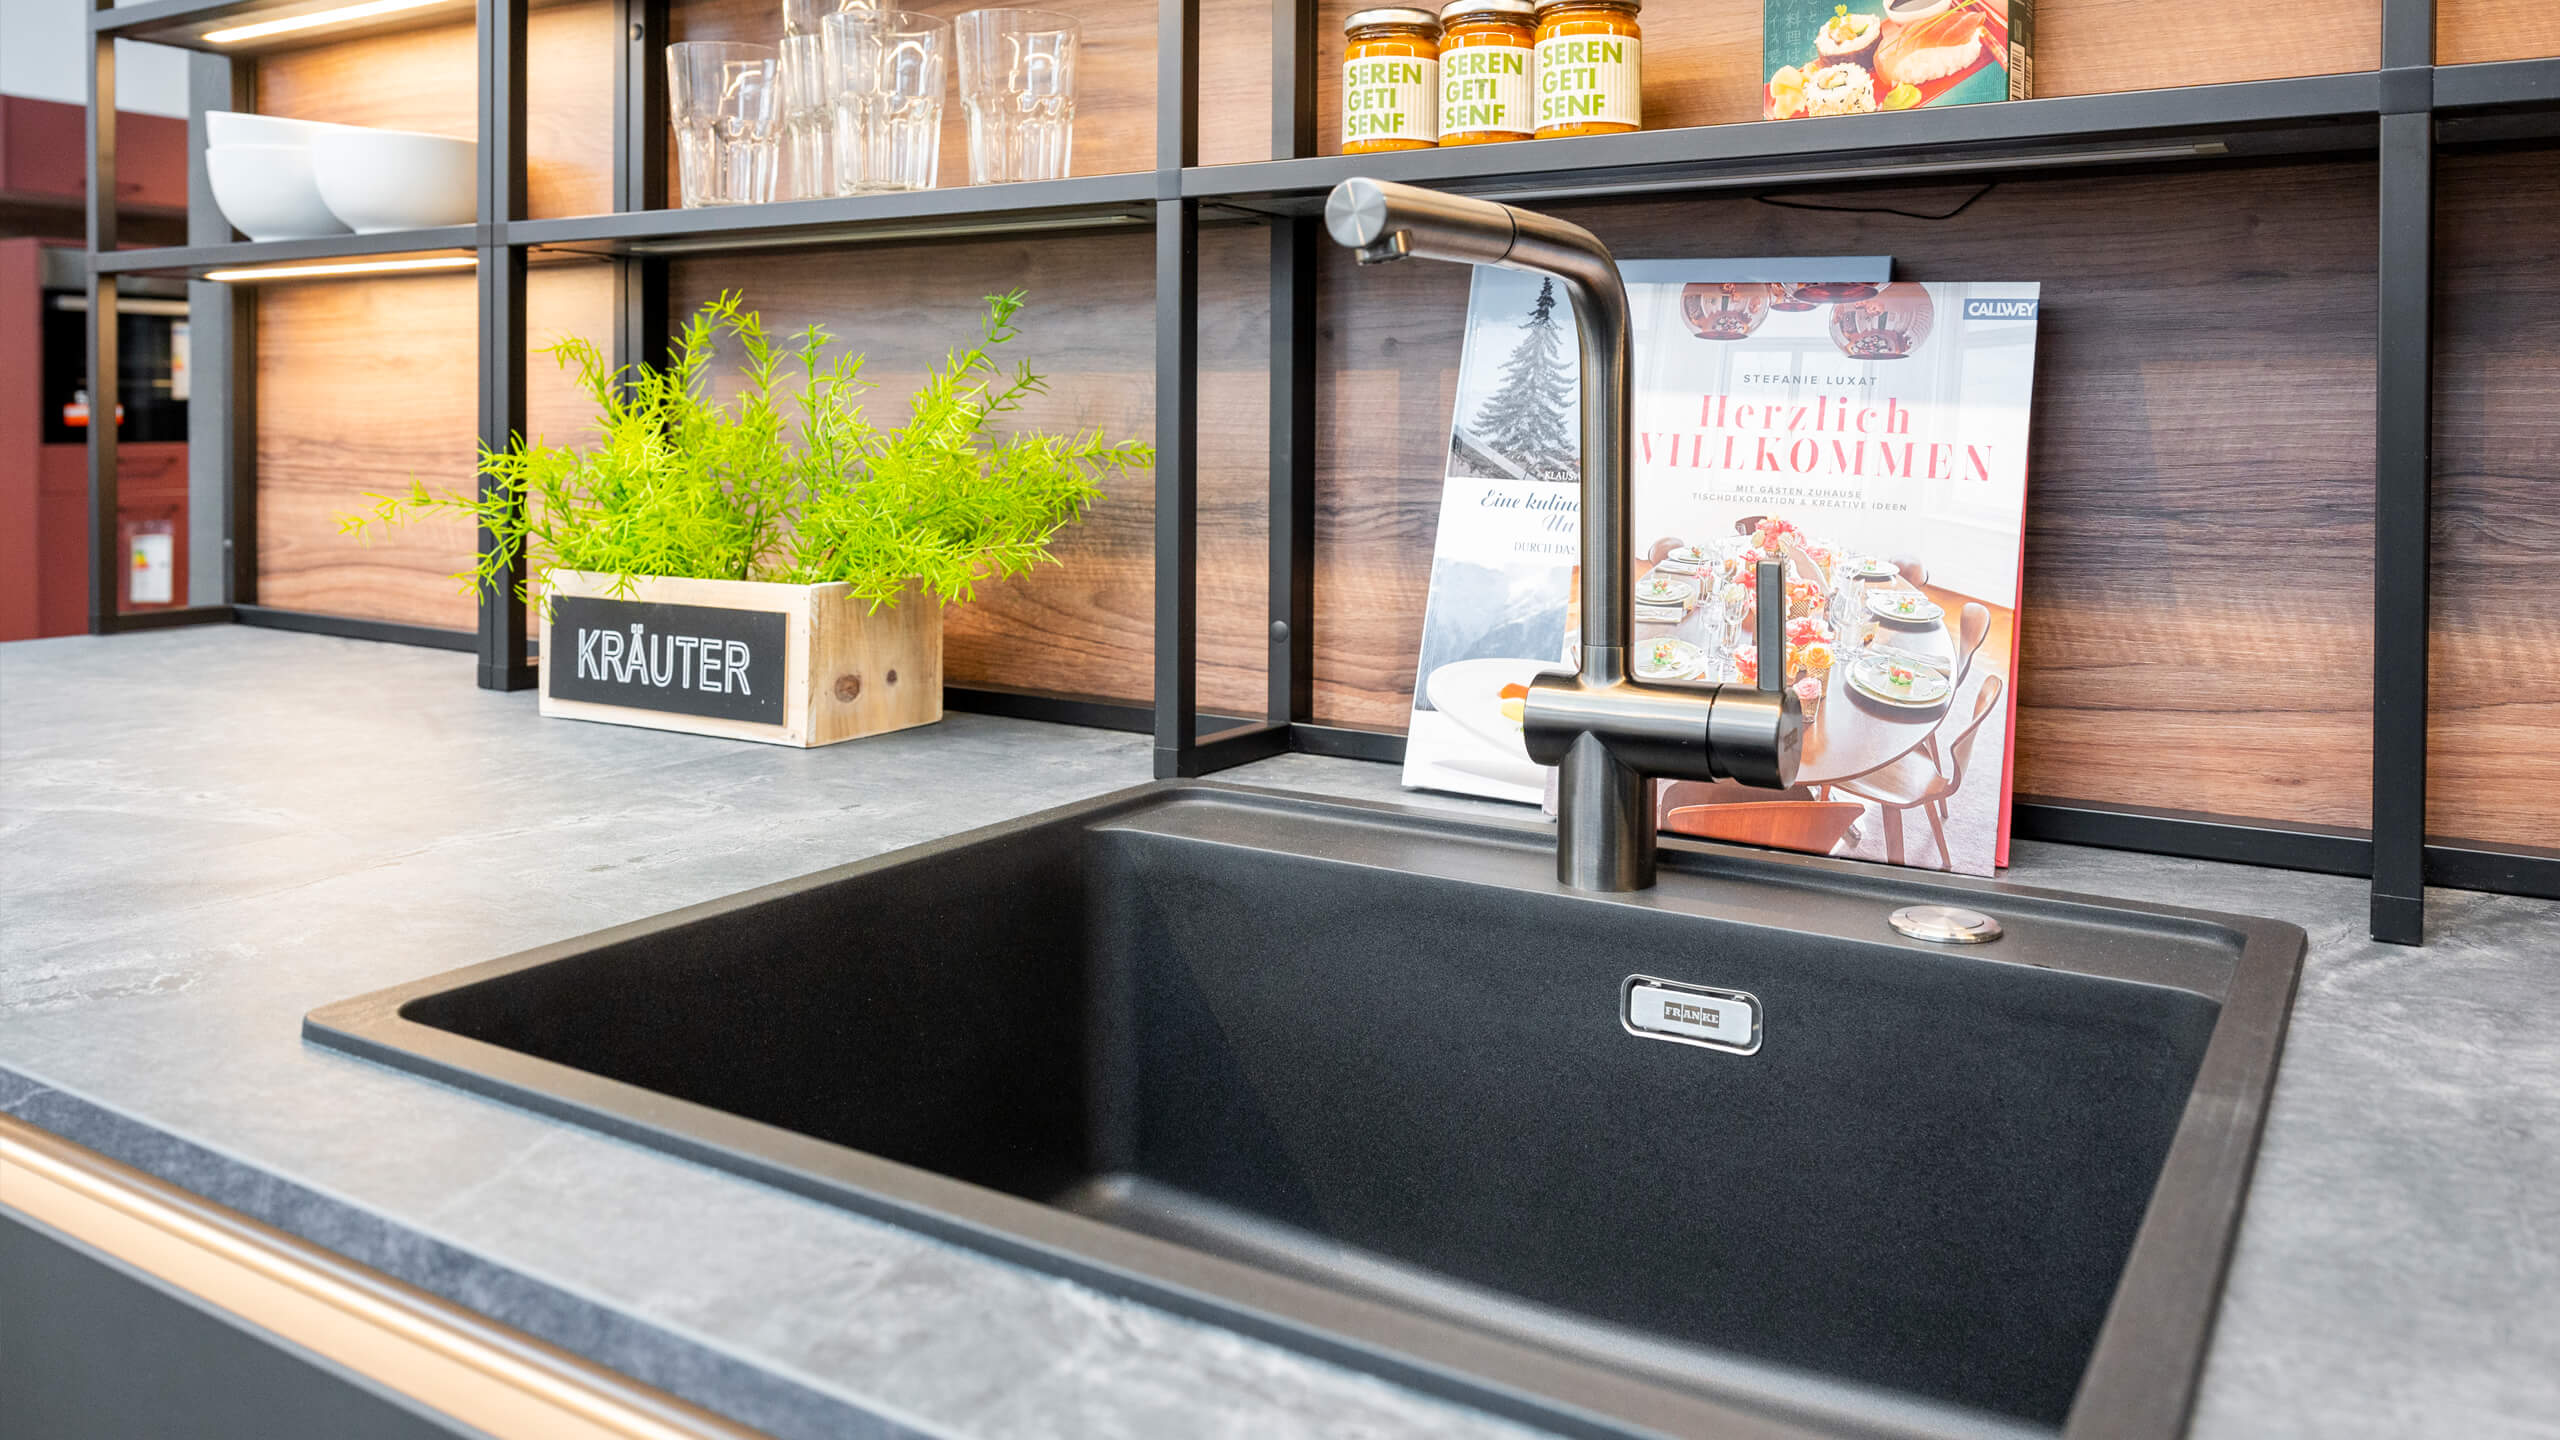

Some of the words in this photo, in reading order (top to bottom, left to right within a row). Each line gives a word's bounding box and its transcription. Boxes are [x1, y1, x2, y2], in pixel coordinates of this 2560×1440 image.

[1447, 53, 1523, 78] SEREN
[1543, 41, 1623, 68] SEREN
[1349, 63, 1422, 87] SEREN
[1543, 68, 1596, 93] GETI
[1348, 88, 1396, 111] GETI
[1446, 79, 1497, 103] GETI
[1446, 104, 1506, 128] SENF
[1543, 94, 1606, 120] SENF
[1348, 113, 1405, 136] SENF
[1967, 302, 2038, 317] CALLWEY
[1743, 374, 1818, 385] STEFANIE
[1826, 375, 1878, 386] LUXAT
[1700, 394, 1910, 434] Herzlich
[1480, 488, 1520, 508] Eine
[1692, 492, 1795, 505] TISCHDEKORATION
[1812, 499, 1865, 509] KREATIVE
[1872, 502, 1908, 512] IDEEN
[1735, 484, 1754, 494] MIT
[1808, 487, 1862, 498] ZUHAUSE
[1514, 541, 1552, 553] DURCH
[577, 623, 751, 696] KRÄUTER
[1664, 1005, 1720, 1025] FRANKE
